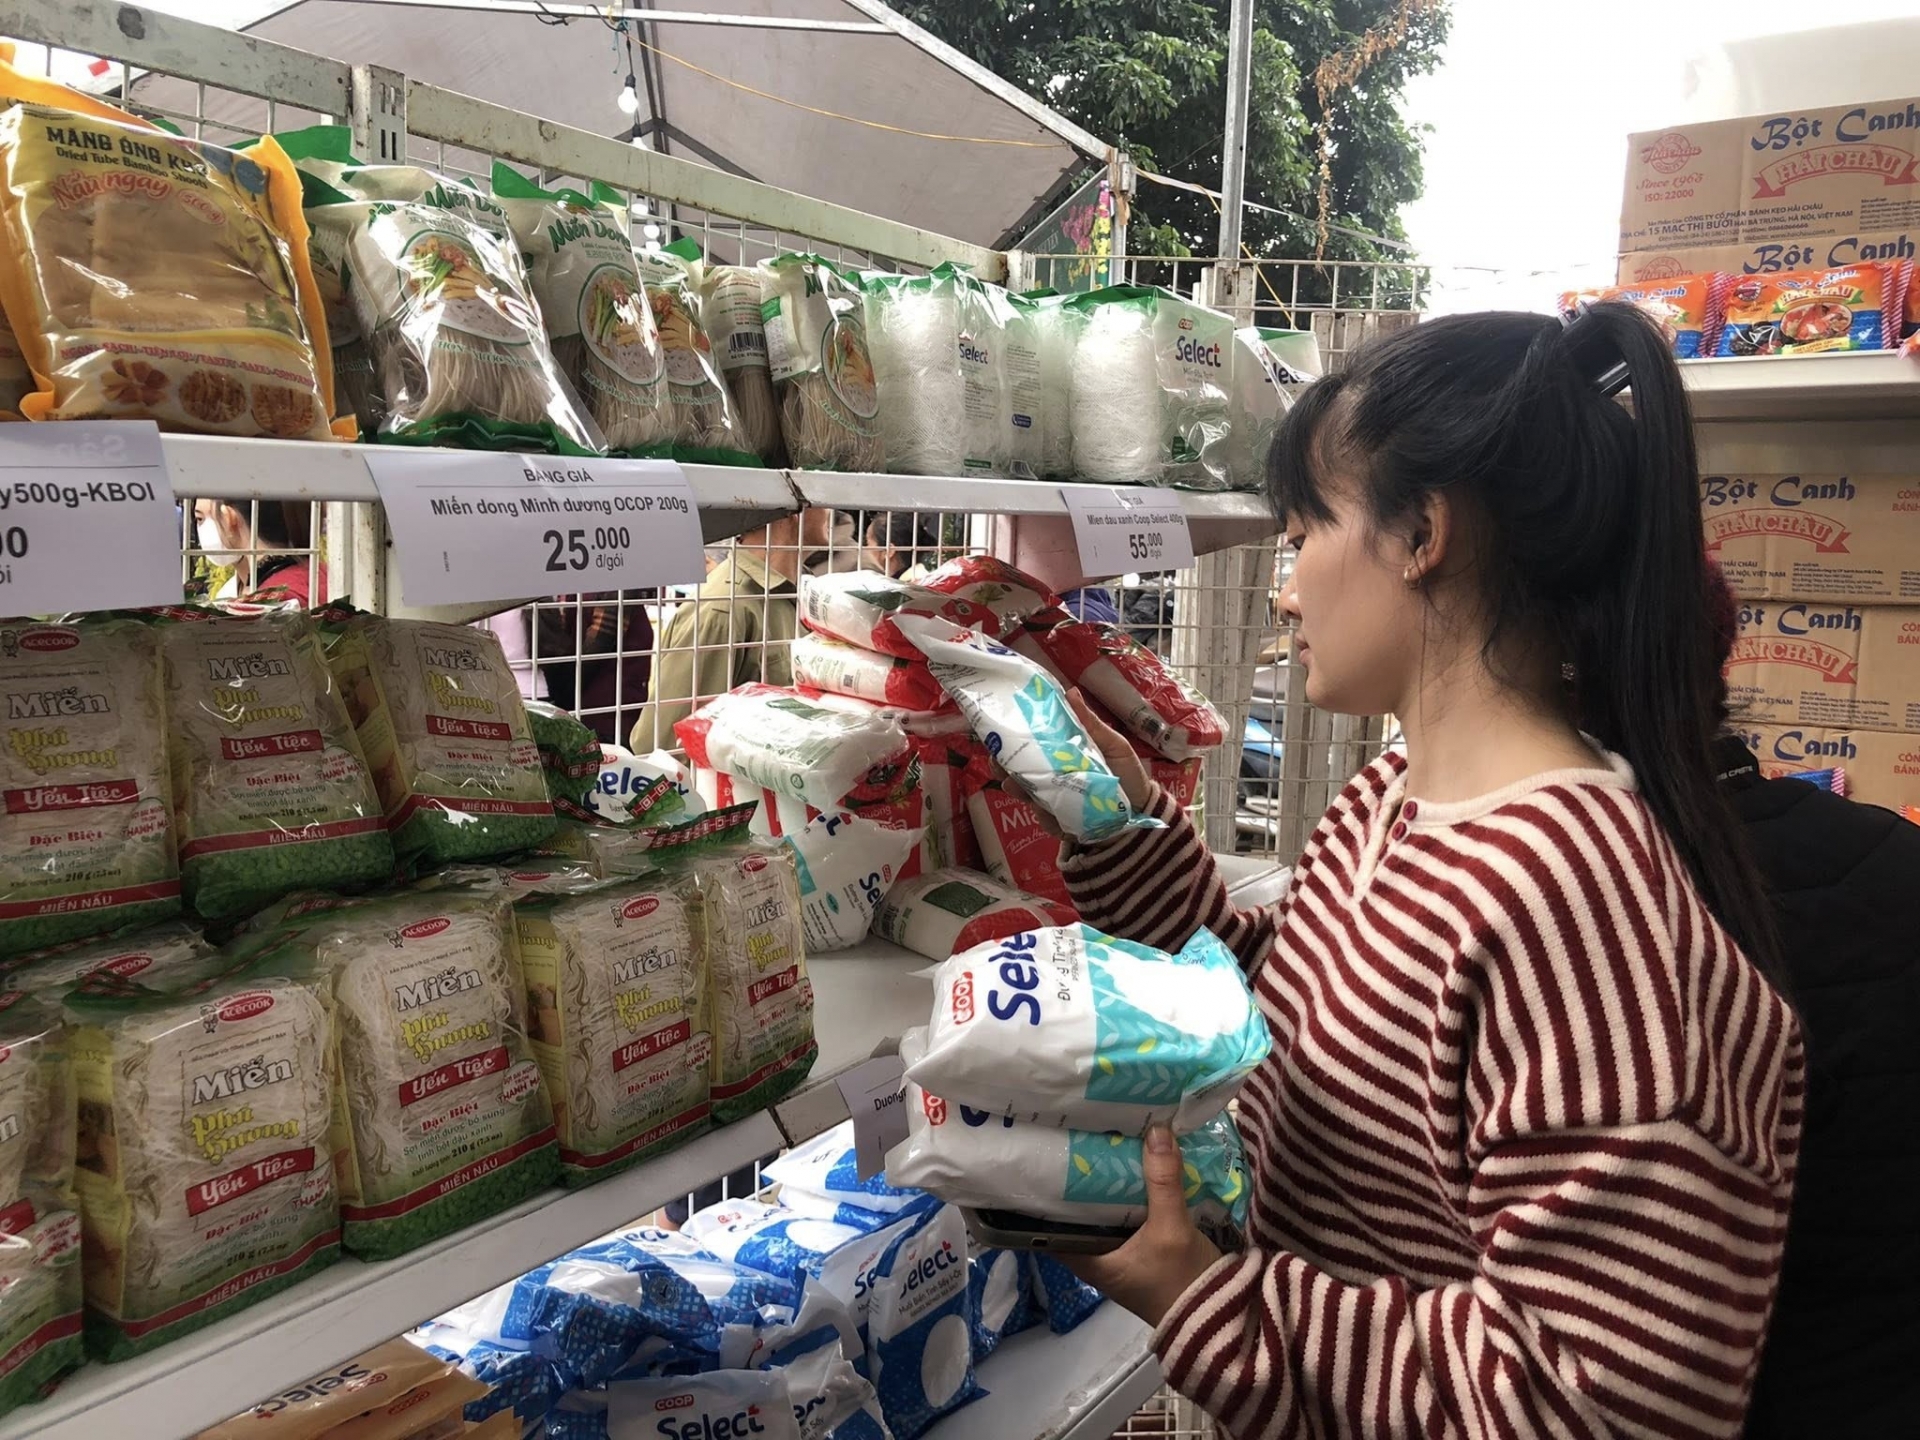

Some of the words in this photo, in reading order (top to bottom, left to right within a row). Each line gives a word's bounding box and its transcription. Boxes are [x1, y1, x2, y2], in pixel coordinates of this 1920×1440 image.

[46, 126, 113, 151] MĂNG
[1751, 117, 1822, 151] Bột
[1835, 103, 1920, 142] Canh
[56, 147, 87, 162] Dried
[92, 152, 119, 165] Tube
[123, 157, 169, 177] Bamboo
[1775, 151, 1826, 183] HẢI
[1827, 149, 1900, 173] CHÂU
[105, 172, 170, 199] ngay
[1636, 179, 1669, 190] Since
[1645, 192, 1662, 202] ISO:
[1664, 189, 1694, 200] 22000
[548, 217, 591, 253] Miến
[1649, 227, 1660, 236] 15
[1743, 244, 1813, 274] Bột
[1827, 235, 1915, 268] Canh
[959, 343, 988, 364] Select
[1176, 335, 1221, 368] Select
[567, 468, 594, 483] GIÁ
[1701, 476, 1758, 506] Bột
[1770, 476, 1855, 506] Canh
[430, 495, 473, 516] Miến
[476, 499, 518, 517] dong
[520, 497, 561, 515] Minh
[563, 497, 612, 515] dương
[614, 497, 654, 511] OCOP
[657, 497, 689, 514] 200g
[1087, 515, 1104, 525] Mien
[1105, 516, 1118, 525] dau
[1118, 515, 1133, 525] xanh
[1133, 514, 1150, 526] Coop
[1150, 514, 1169, 524] Select
[1713, 510, 1762, 539] HẢI
[1762, 513, 1832, 542] CHÂU
[595, 553, 624, 571] đ/gói
[1777, 605, 1861, 634] Canh
[208, 652, 290, 681] Miến
[424, 647, 492, 672] Miến
[1769, 642, 1837, 670] CHÂU
[8, 687, 110, 719] Miến
[436, 717, 466, 734] Yến
[471, 722, 500, 739] Tiệc
[230, 739, 268, 758] Yến
[271, 734, 311, 750] Tiệc
[1774, 731, 1857, 761] Canh
[23, 786, 72, 811] Yến
[77, 785, 124, 803] Tiệc
[462, 801, 490, 812] MIẾN
[492, 800, 514, 812] NẤU
[39, 897, 79, 914] MIẾN
[81, 892, 113, 909] NẤU
[858, 872, 884, 909] Sel
[747, 897, 786, 929] Miến
[613, 945, 677, 986] Miến
[396, 966, 483, 1012] Miến
[753, 981, 773, 998] Yến
[622, 1040, 650, 1065] Yến
[653, 1029, 681, 1046] Tiệc
[192, 1054, 294, 1106] Miến
[412, 1070, 449, 1098] Yến
[454, 1057, 495, 1078] Tiệc
[422, 1115, 447, 1132] Đặc
[449, 1102, 479, 1119] Biệt
[482, 1107, 505, 1120] sung
[470, 1123, 492, 1137] xanh
[633, 1133, 657, 1150] MIẾN
[659, 1120, 679, 1136] NẤU
[451, 1144, 468, 1158] 210
[200, 1171, 247, 1206] Yến
[253, 1155, 297, 1182] Tiệc
[439, 1171, 471, 1193] MIẾN
[472, 1157, 499, 1178] NẤU
[205, 1282, 241, 1307] MIẾN
[243, 1266, 276, 1289] NẤU
[656, 1395, 694, 1410] COOP
[657, 1411, 765, 1440] Select
